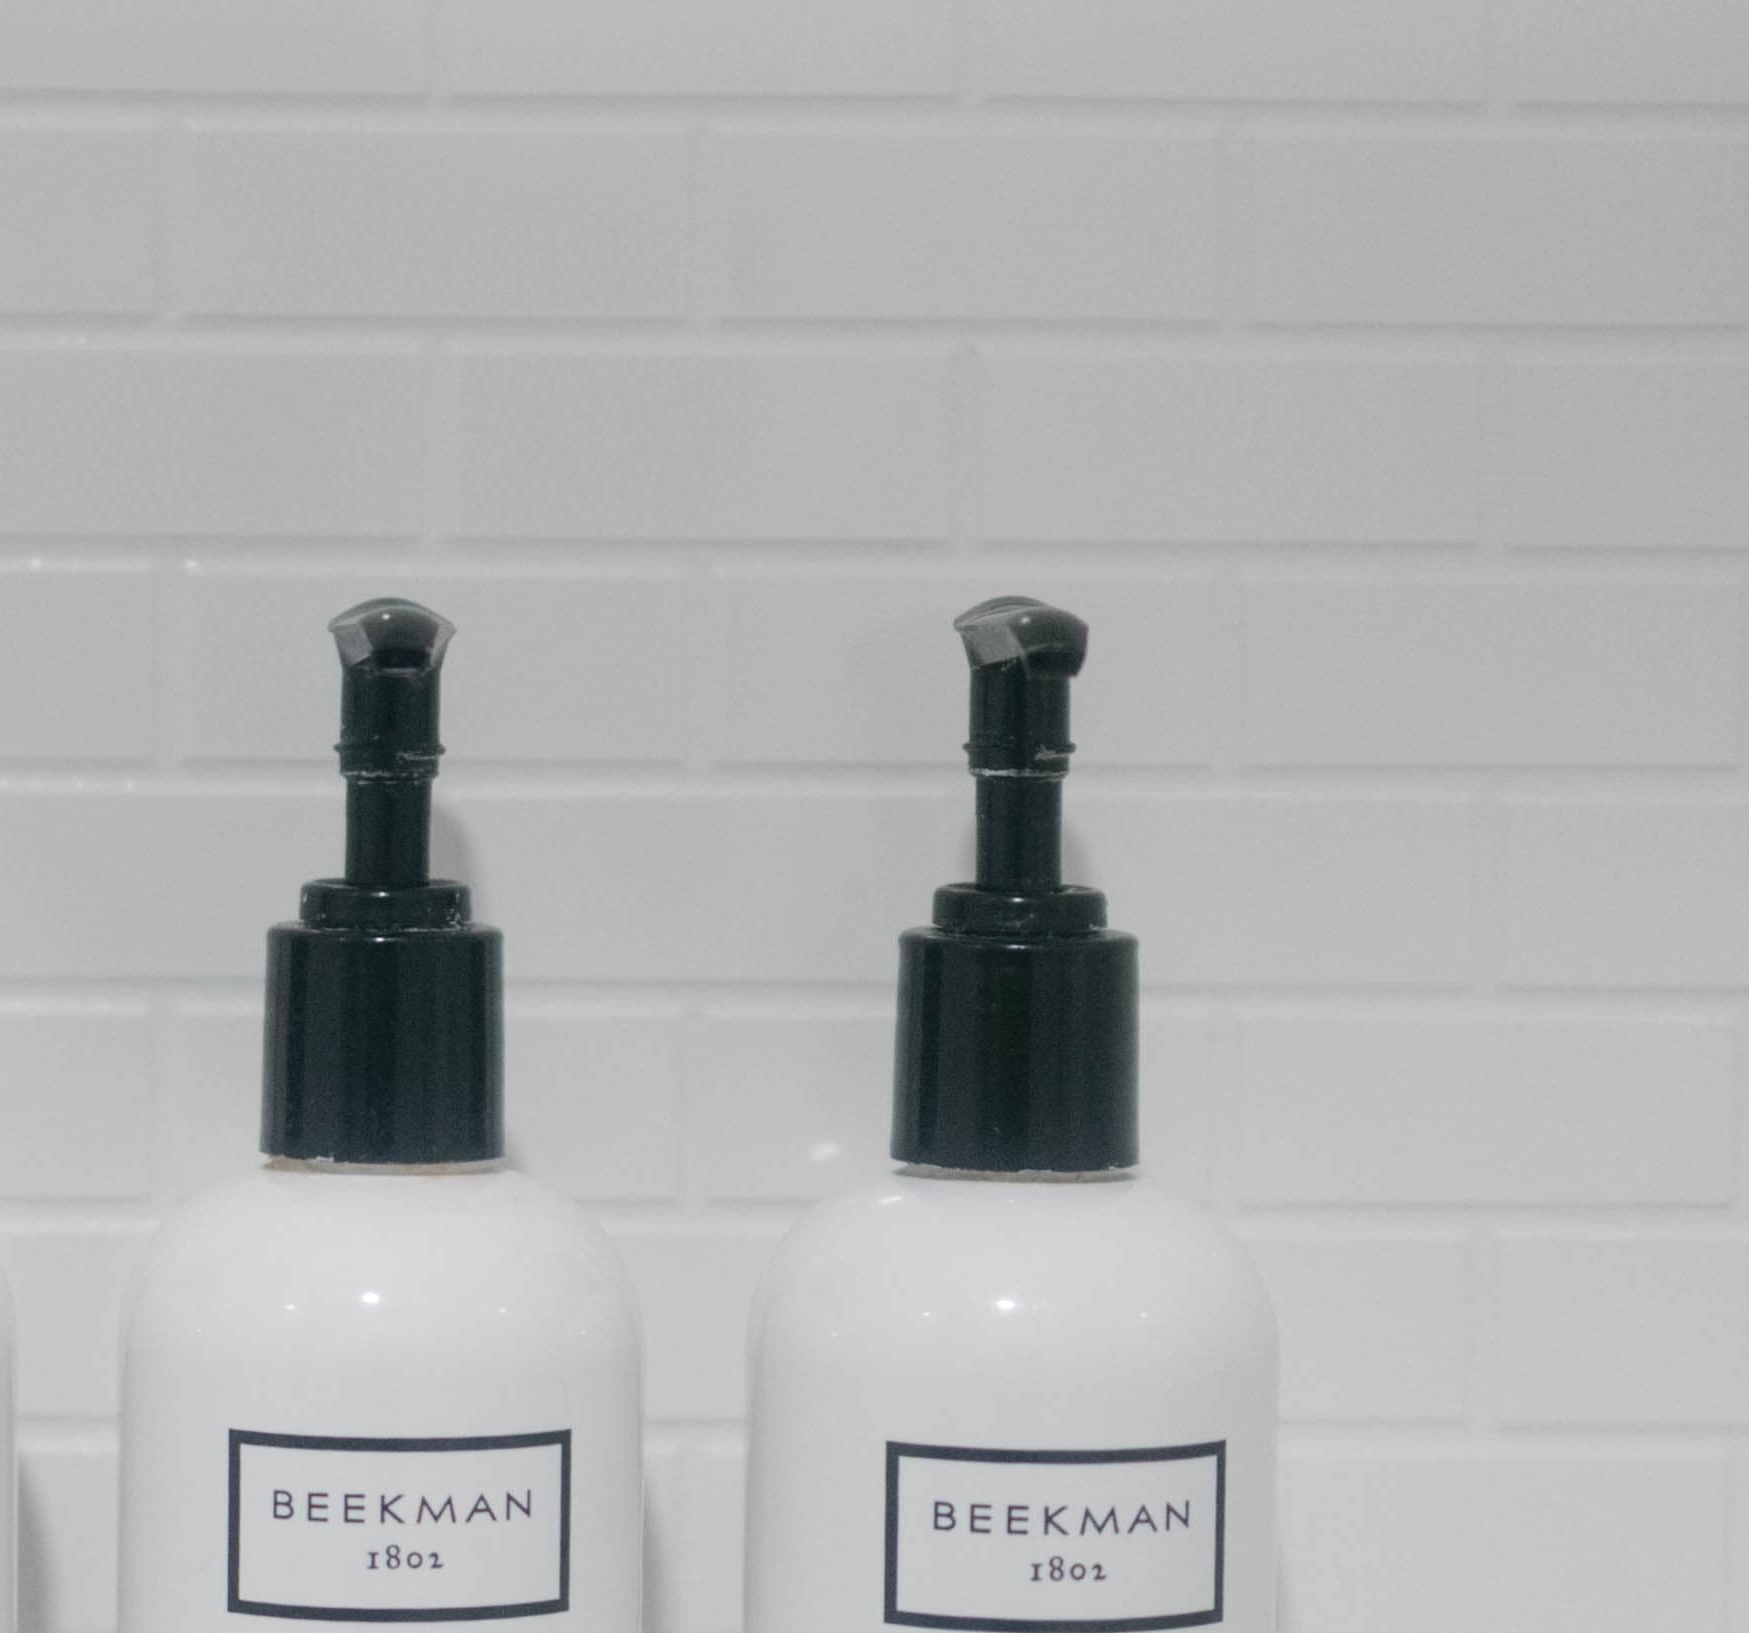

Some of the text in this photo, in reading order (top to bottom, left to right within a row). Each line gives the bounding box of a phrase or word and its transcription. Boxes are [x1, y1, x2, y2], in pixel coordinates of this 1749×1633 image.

[272, 1488, 532, 1525] BEEKMAN
[932, 1499, 1191, 1537] BEEKMAN
[366, 1543, 445, 1571] 1802
[1029, 1555, 1108, 1583] 1802
